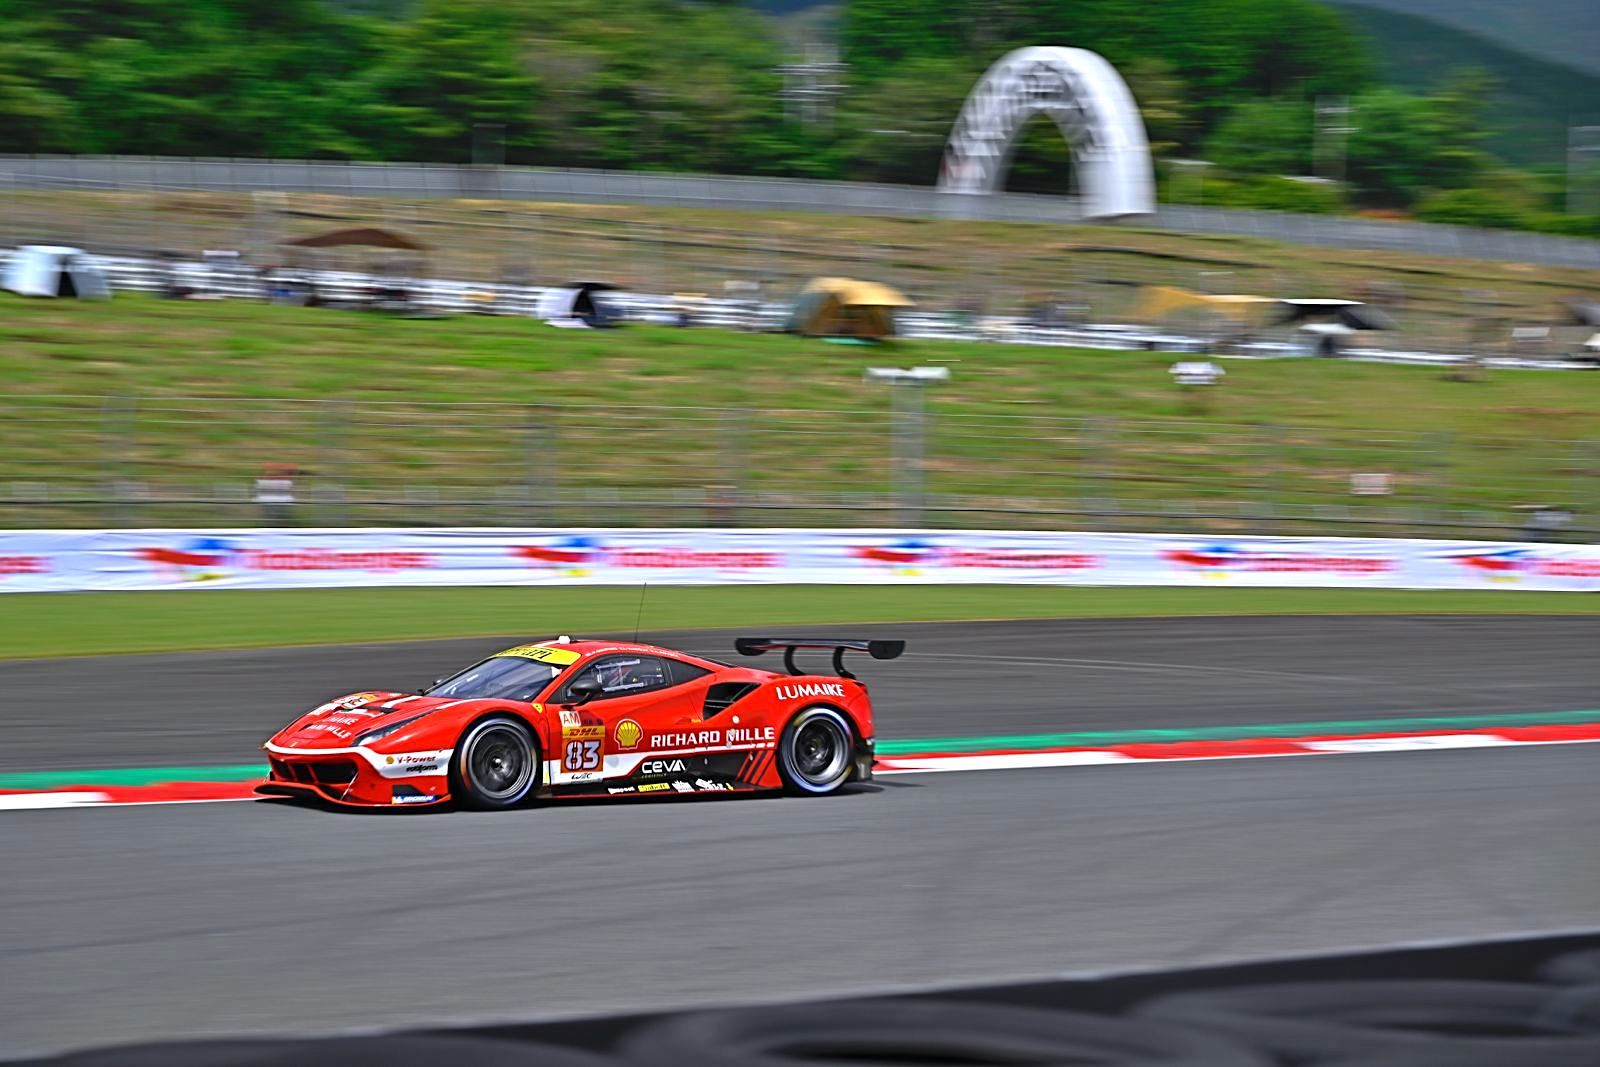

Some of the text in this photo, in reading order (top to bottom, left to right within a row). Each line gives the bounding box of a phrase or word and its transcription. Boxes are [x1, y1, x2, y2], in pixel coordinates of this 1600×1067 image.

[776, 684, 845, 700] LUMAIKE
[563, 712, 580, 725] AM
[569, 727, 599, 736] DHL
[651, 727, 775, 747] RICHARD MILLE
[397, 756, 436, 764] V-Power
[565, 741, 601, 770] 83
